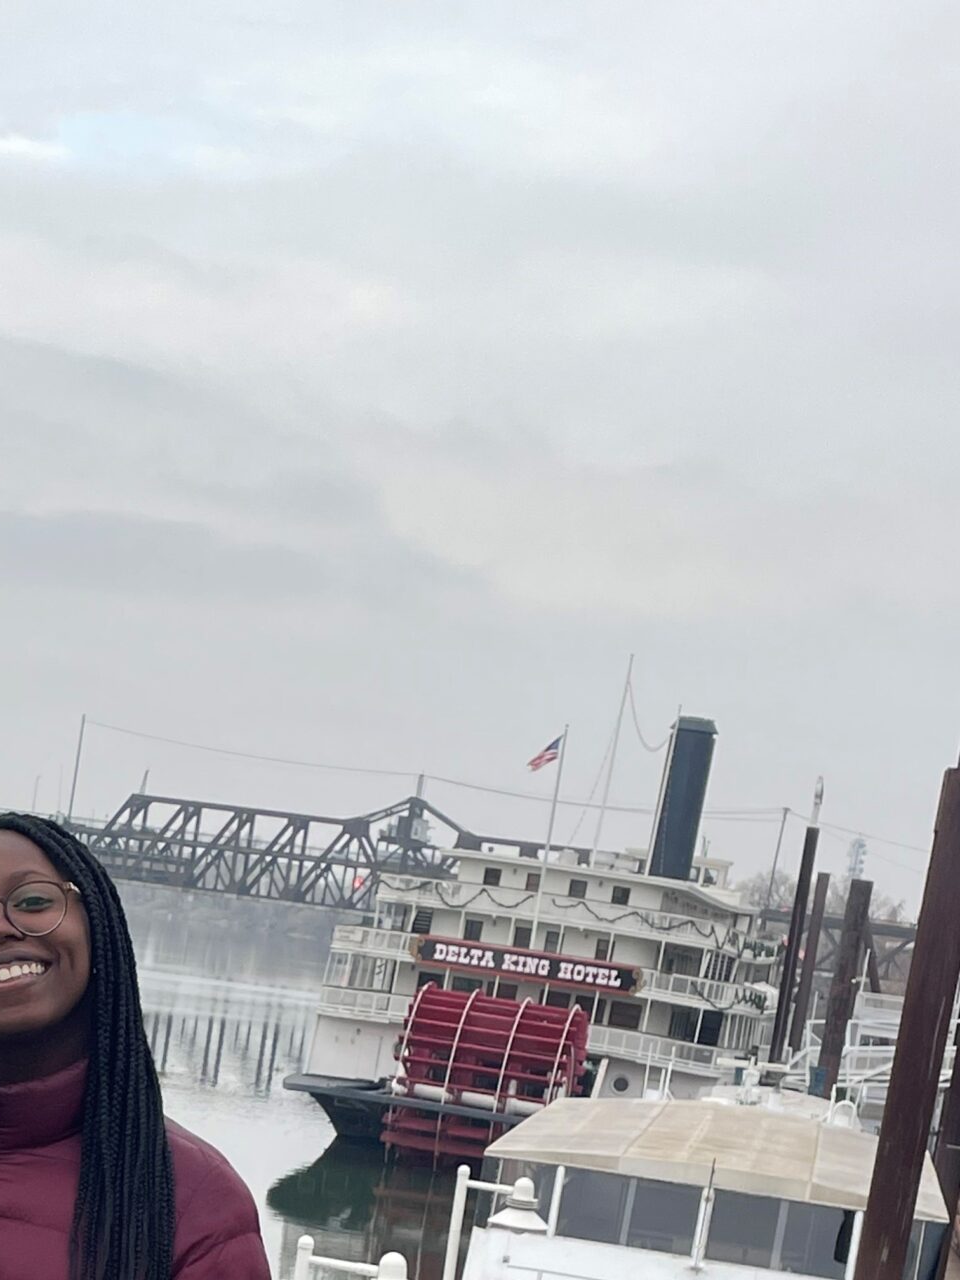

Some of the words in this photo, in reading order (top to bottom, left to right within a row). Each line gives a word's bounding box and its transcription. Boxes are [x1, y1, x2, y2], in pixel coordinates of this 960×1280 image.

[433, 943, 495, 968] DELTA
[502, 953, 550, 976] KING
[557, 962, 622, 987] HOTEL
